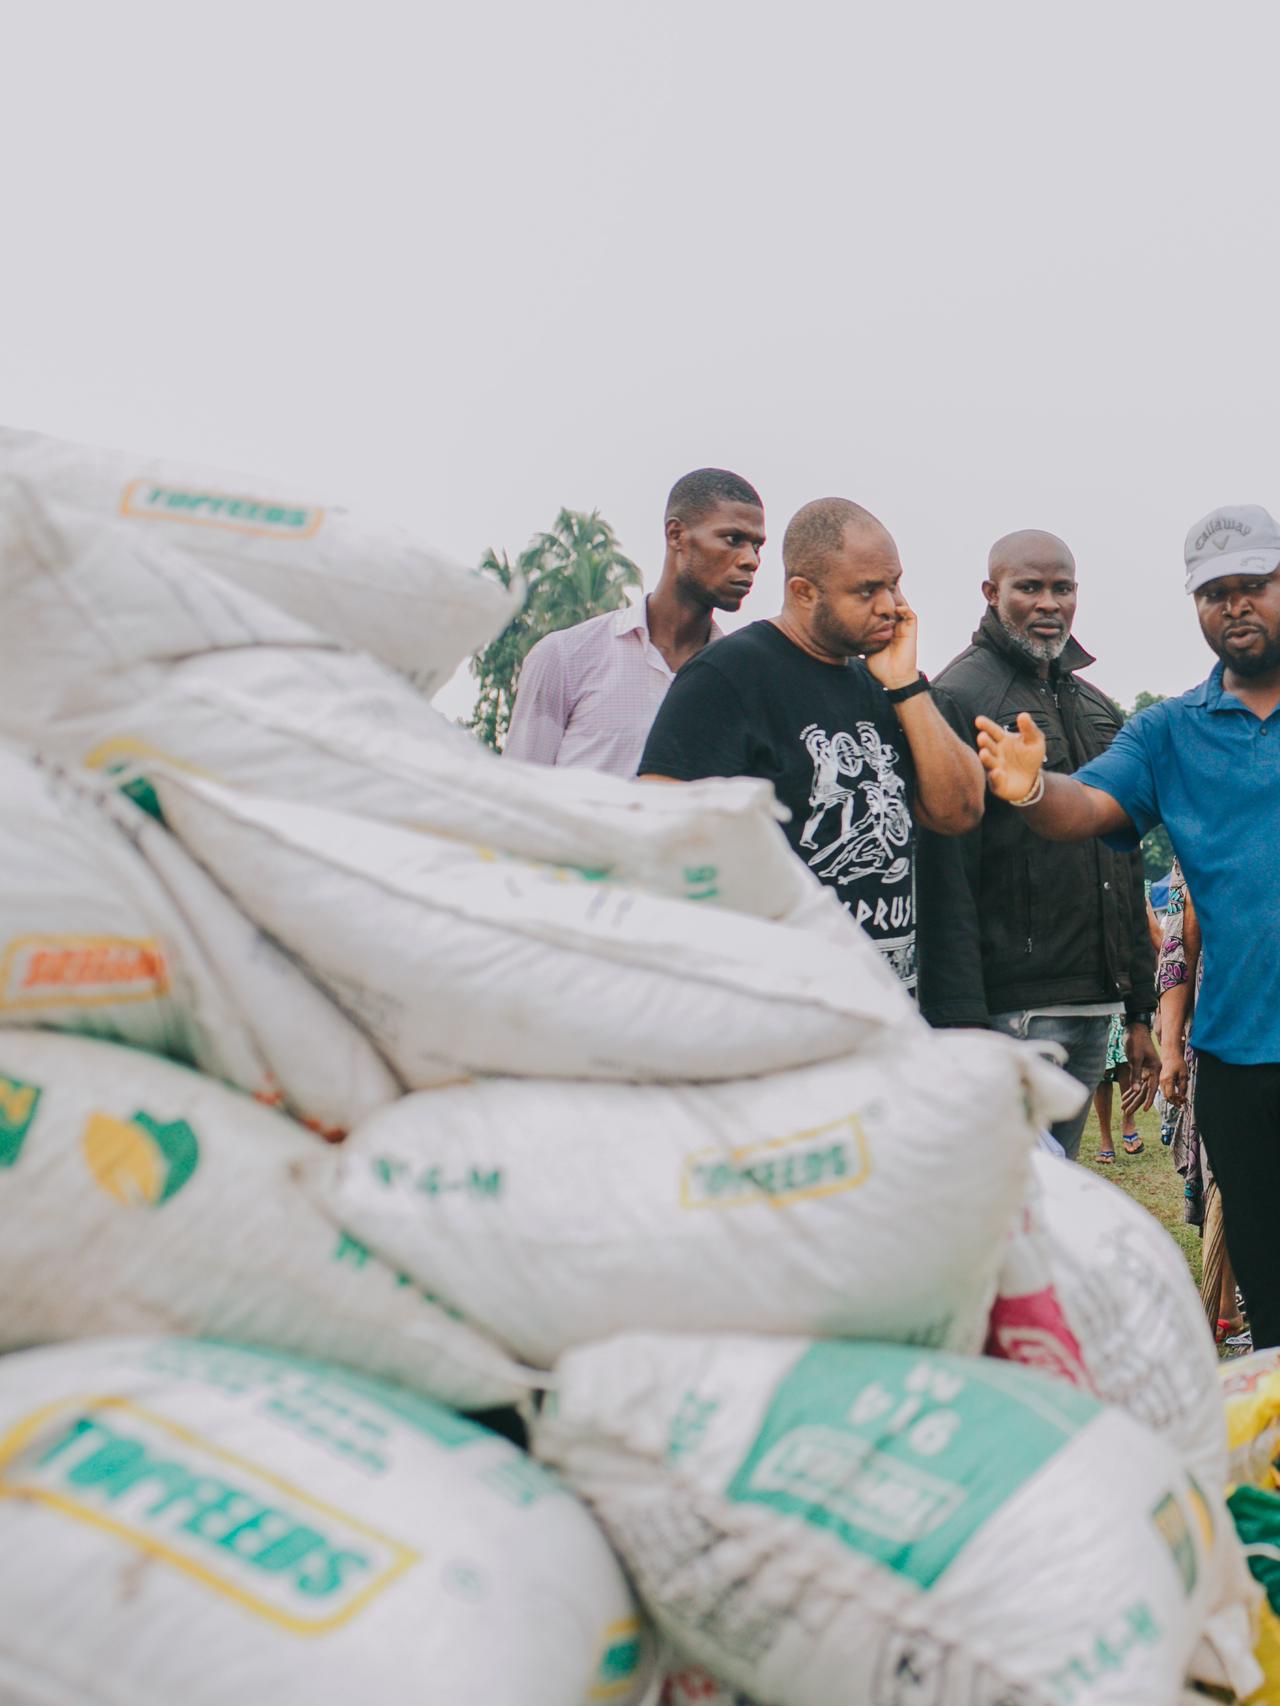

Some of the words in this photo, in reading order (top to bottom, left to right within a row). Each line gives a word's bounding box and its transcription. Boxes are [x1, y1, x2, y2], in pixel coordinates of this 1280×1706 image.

[1194, 517, 1252, 552] Callaway
[842, 893, 912, 933] PRUS
[36, 1416, 370, 1600] TOPFEEDS
